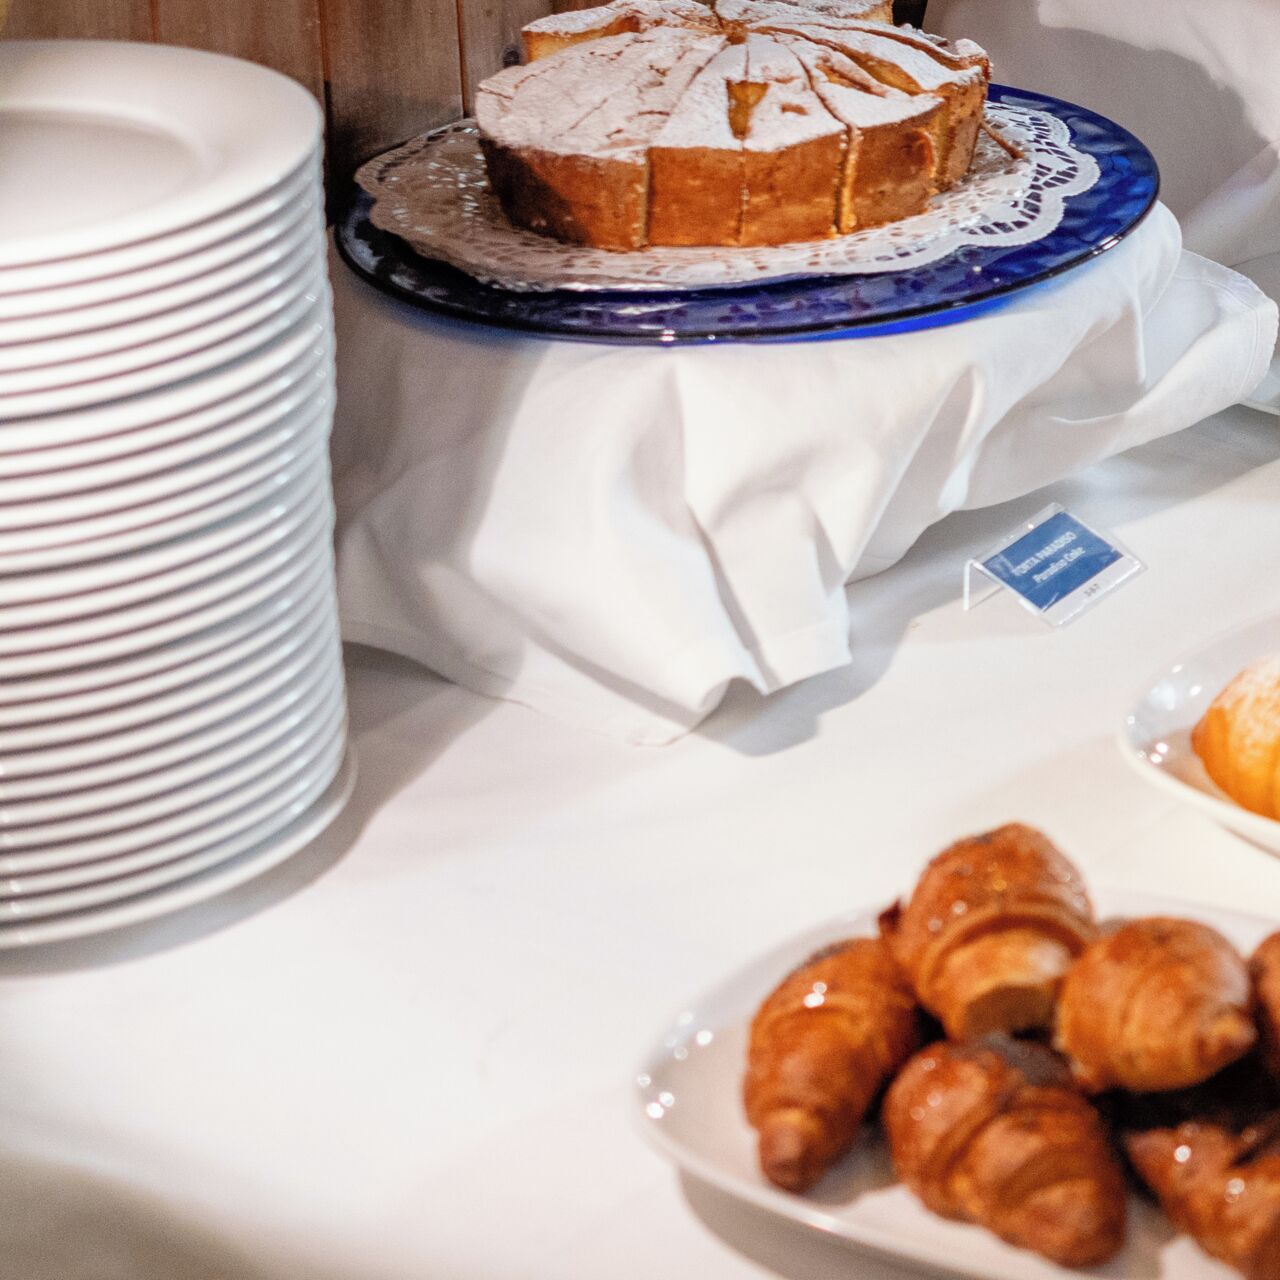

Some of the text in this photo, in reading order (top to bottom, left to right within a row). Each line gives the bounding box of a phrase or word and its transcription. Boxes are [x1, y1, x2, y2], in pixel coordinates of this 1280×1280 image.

[1011, 531, 1077, 576] TORTA PARADISO
[1064, 546, 1086, 563] Cake
